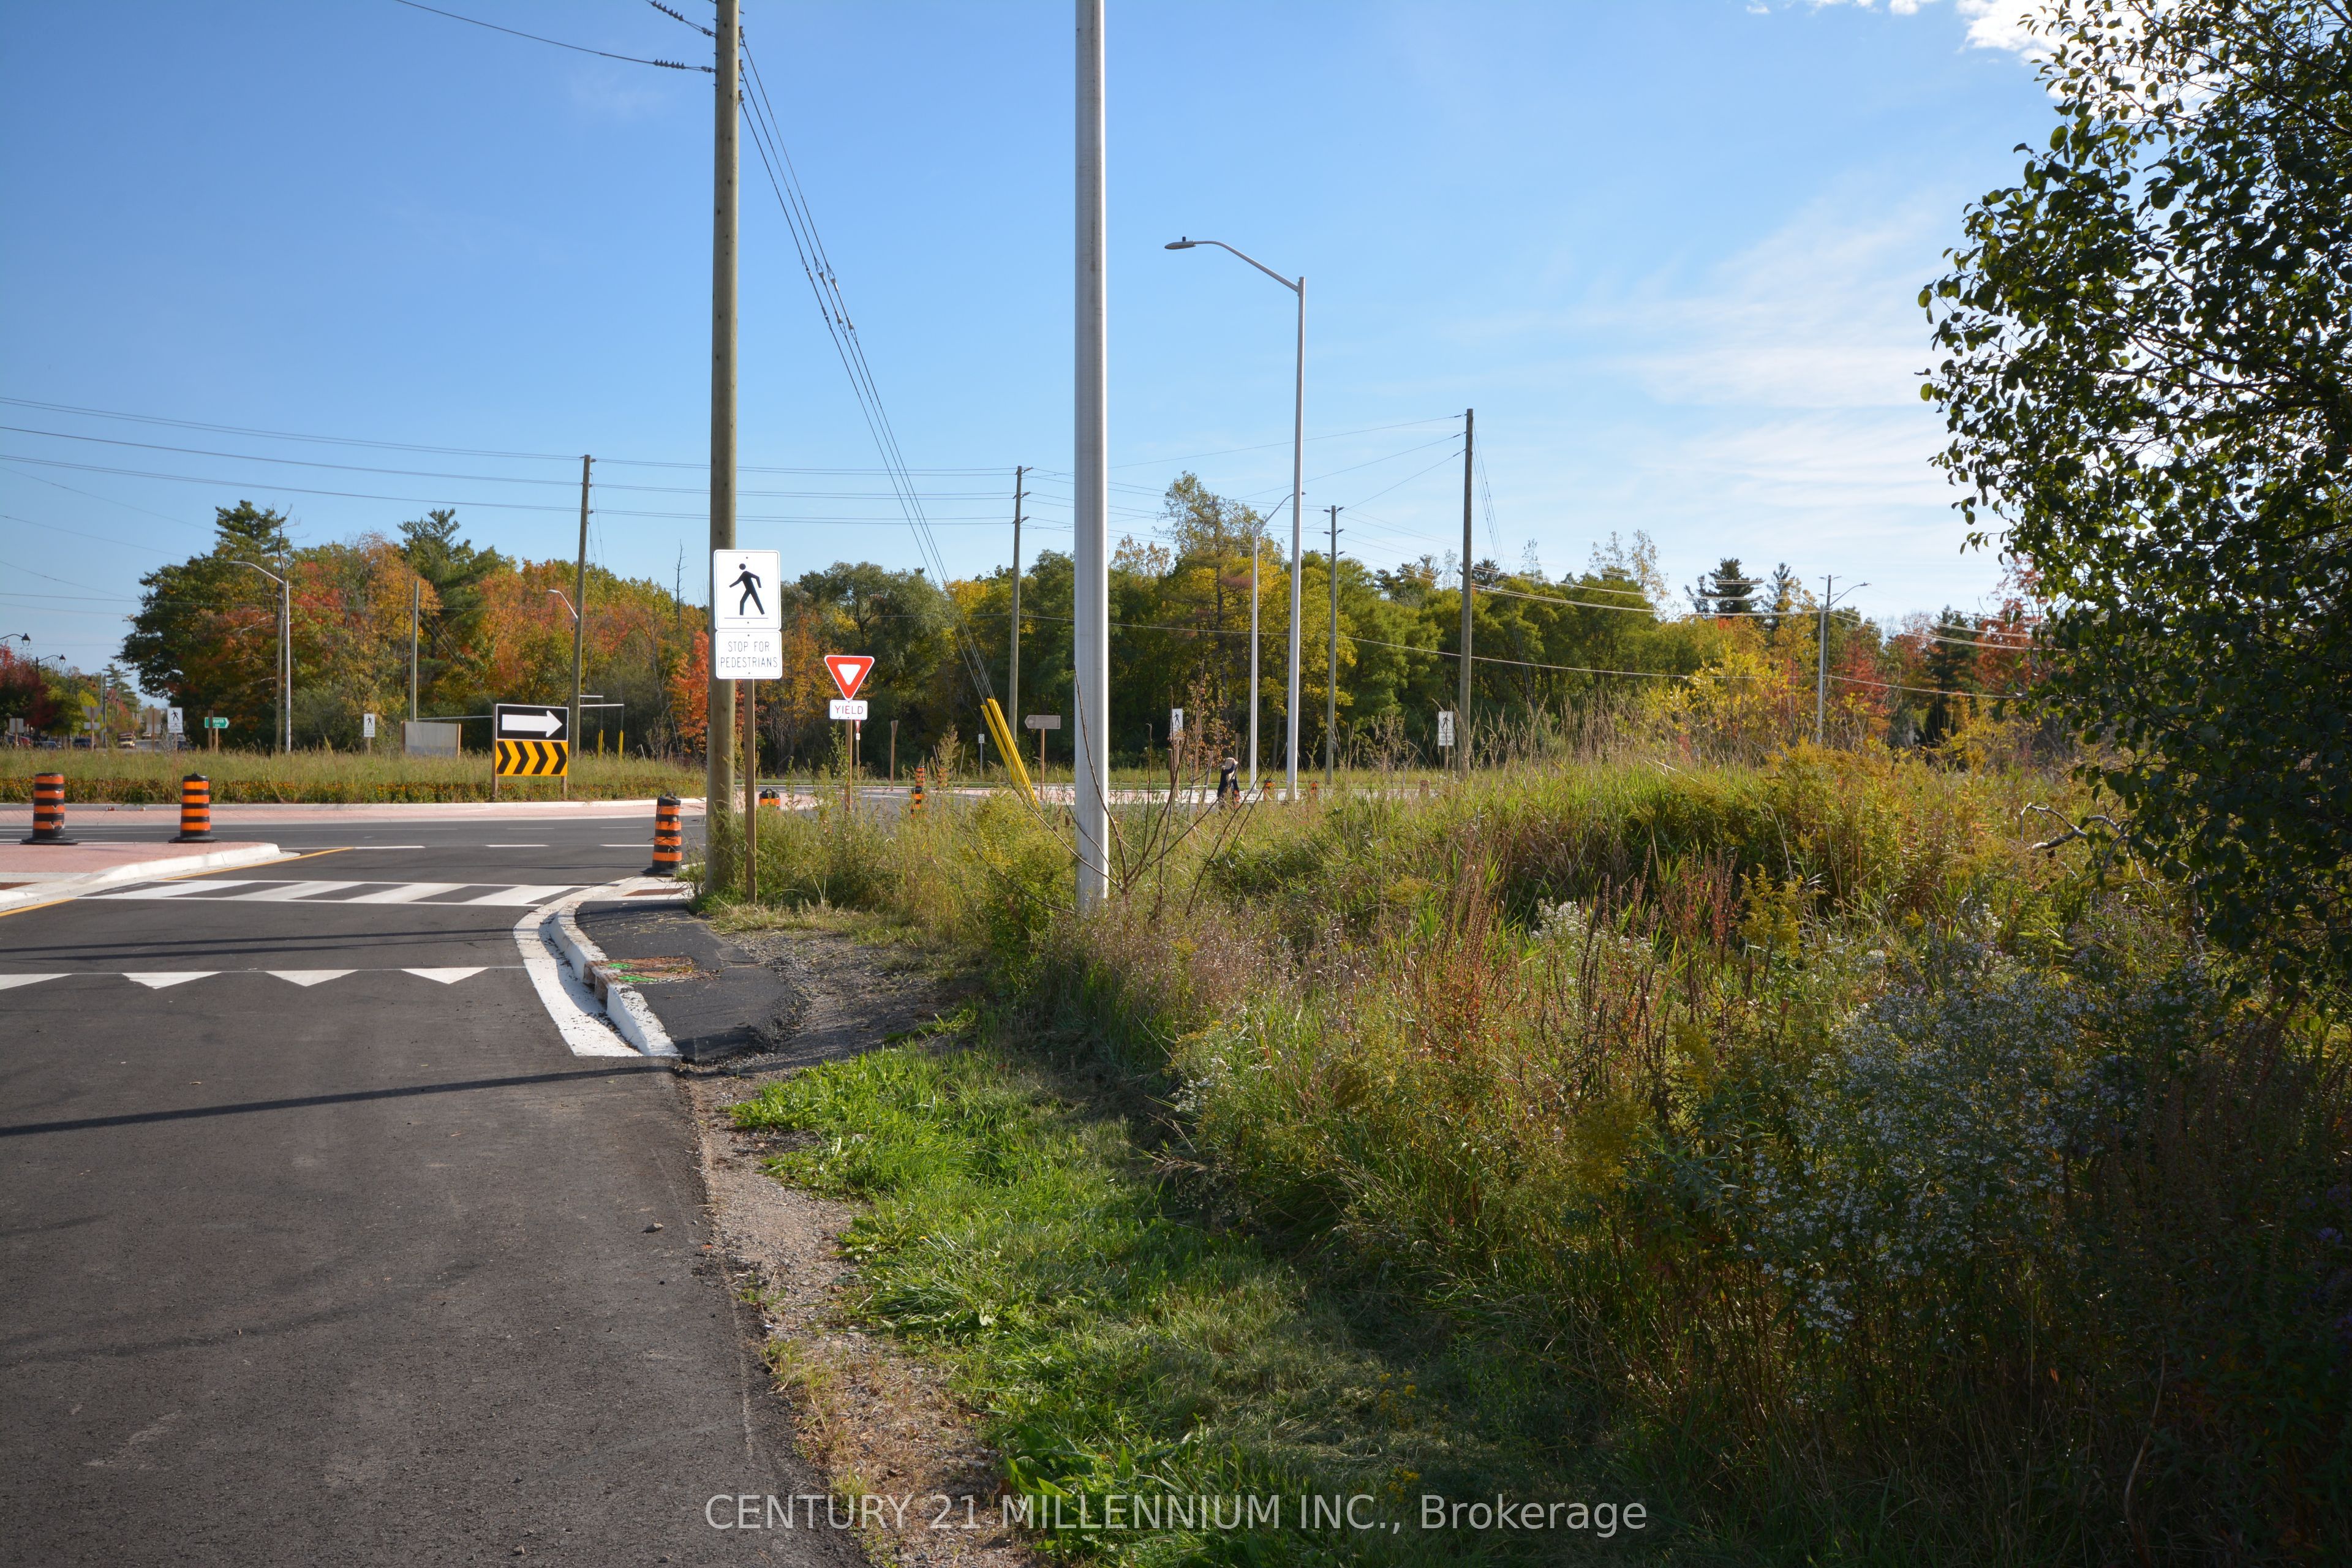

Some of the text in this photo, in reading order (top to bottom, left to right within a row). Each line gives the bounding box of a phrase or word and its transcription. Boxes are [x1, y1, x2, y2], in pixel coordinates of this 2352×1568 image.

[728, 641, 770, 652] STOP FOR
[720, 657, 778, 668] PEDESTRIANS
[834, 705, 864, 715] YIELD
